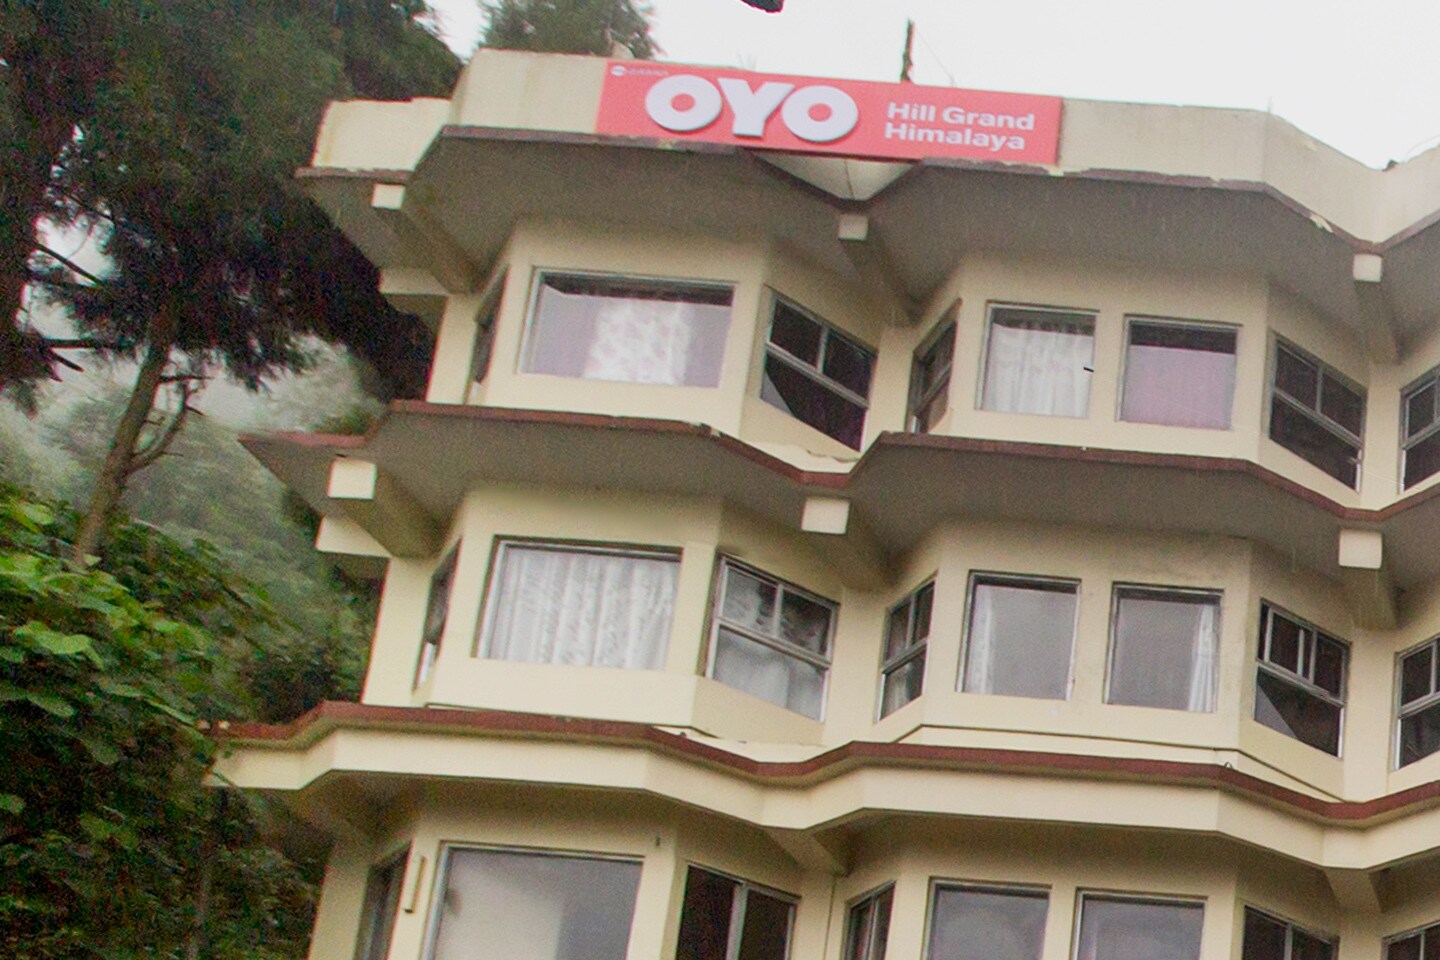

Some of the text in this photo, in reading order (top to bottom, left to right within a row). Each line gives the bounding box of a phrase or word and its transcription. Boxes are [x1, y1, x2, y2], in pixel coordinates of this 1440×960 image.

[645, 74, 859, 142] OYO
[887, 102, 1035, 130] Hill Grand
[884, 122, 1025, 151] Himalaya
